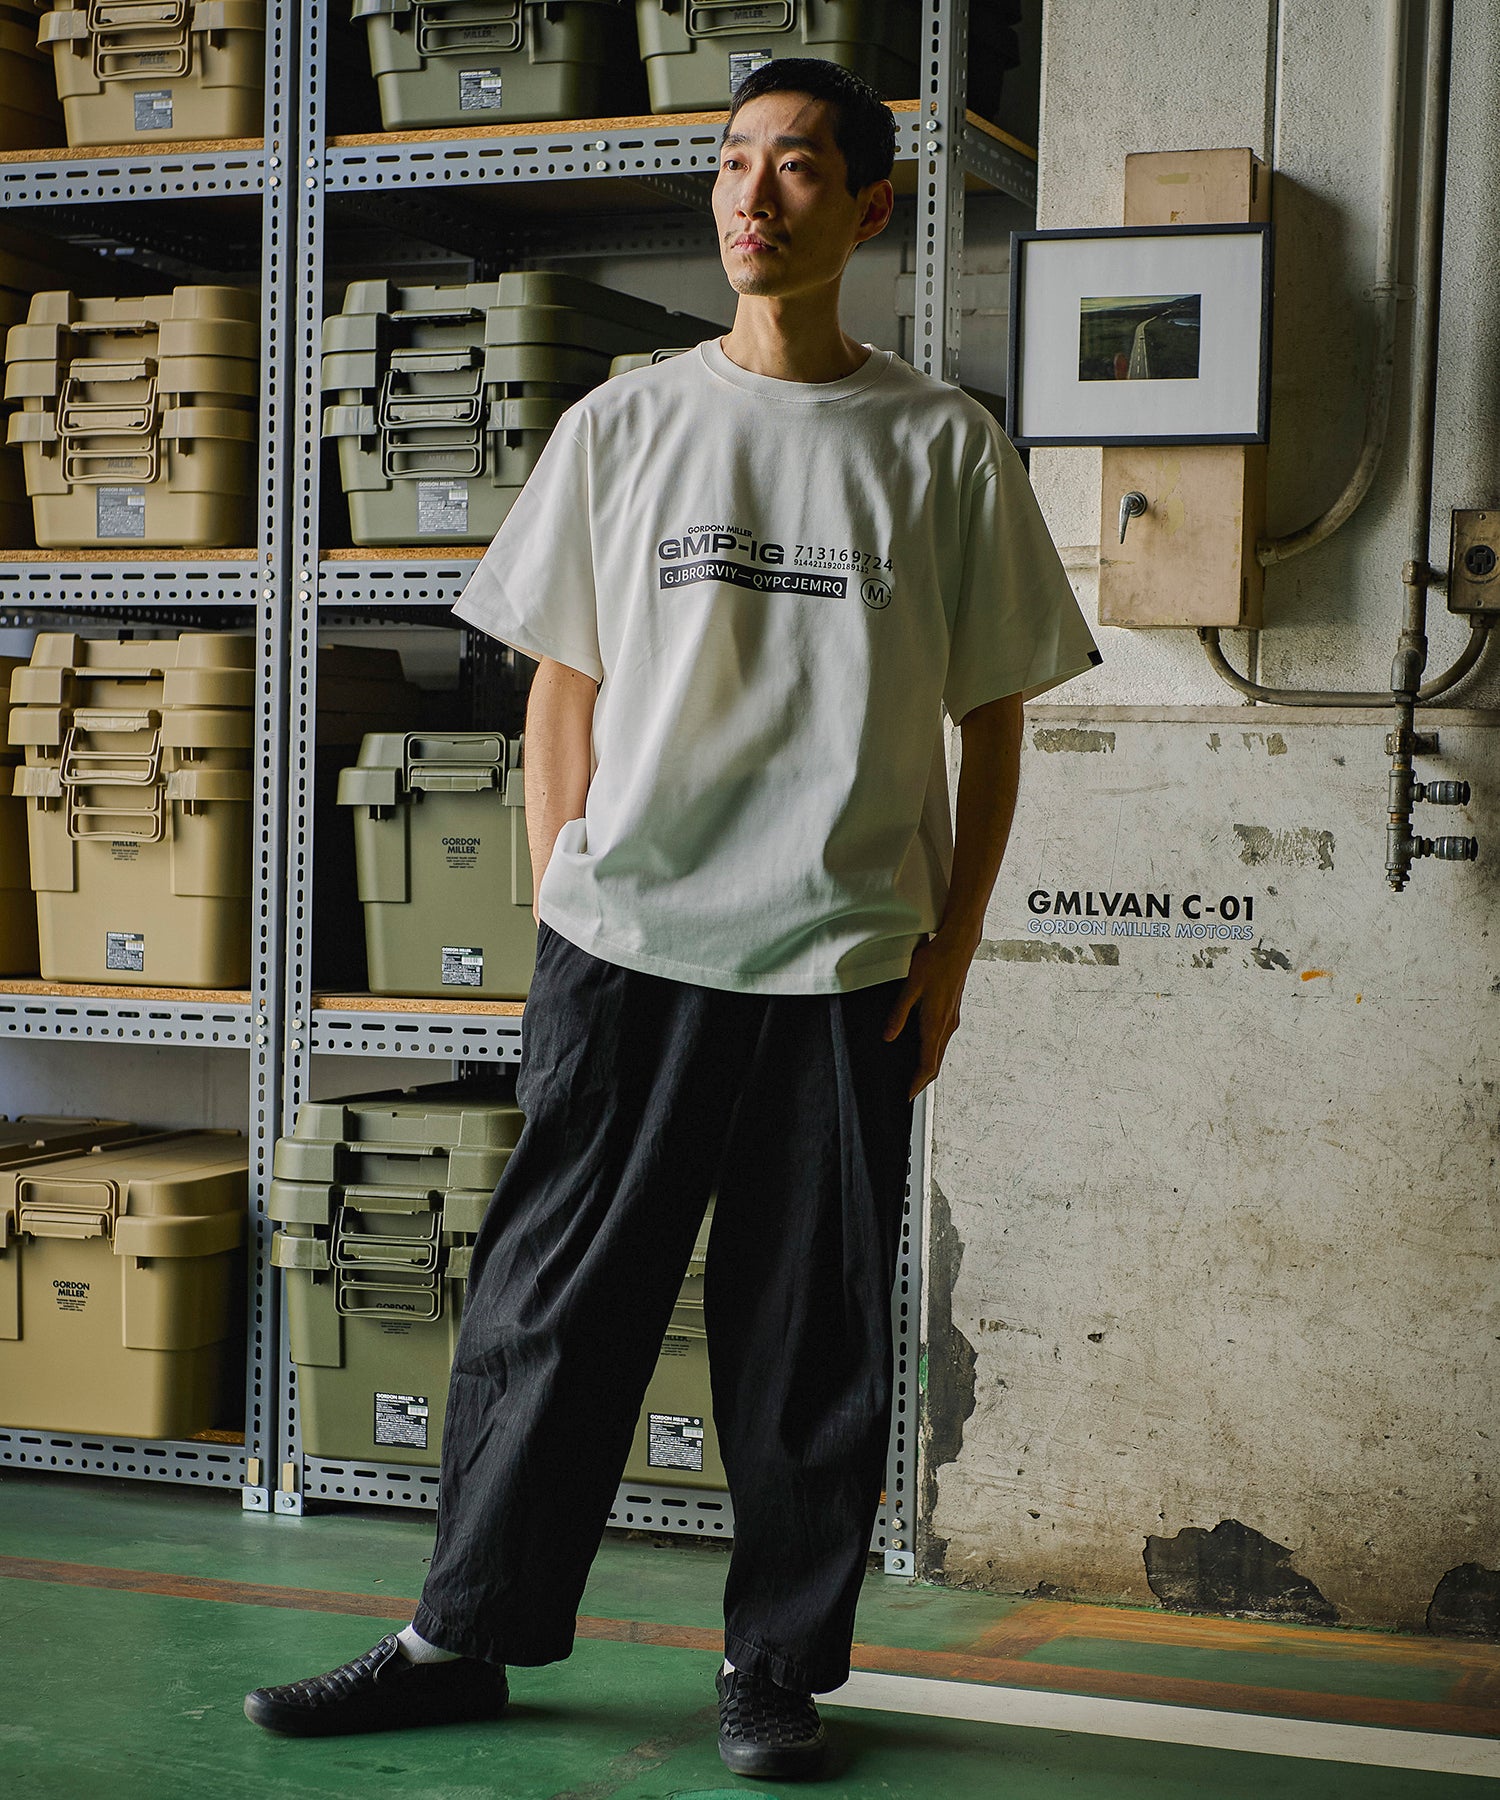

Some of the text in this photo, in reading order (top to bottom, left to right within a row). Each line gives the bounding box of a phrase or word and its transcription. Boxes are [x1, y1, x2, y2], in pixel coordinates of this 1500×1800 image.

[688, 525, 753, 538] GORDON MILLER
[658, 534, 785, 565] GMP-IG
[795, 545, 893, 571] 713169724
[441, 837, 480, 846] GORDON
[1027, 889, 1254, 921] GMLVAN C-01
[1027, 917, 1254, 940] GORDON MILLER MOTORS
[52, 1280, 90, 1290] GORDON
